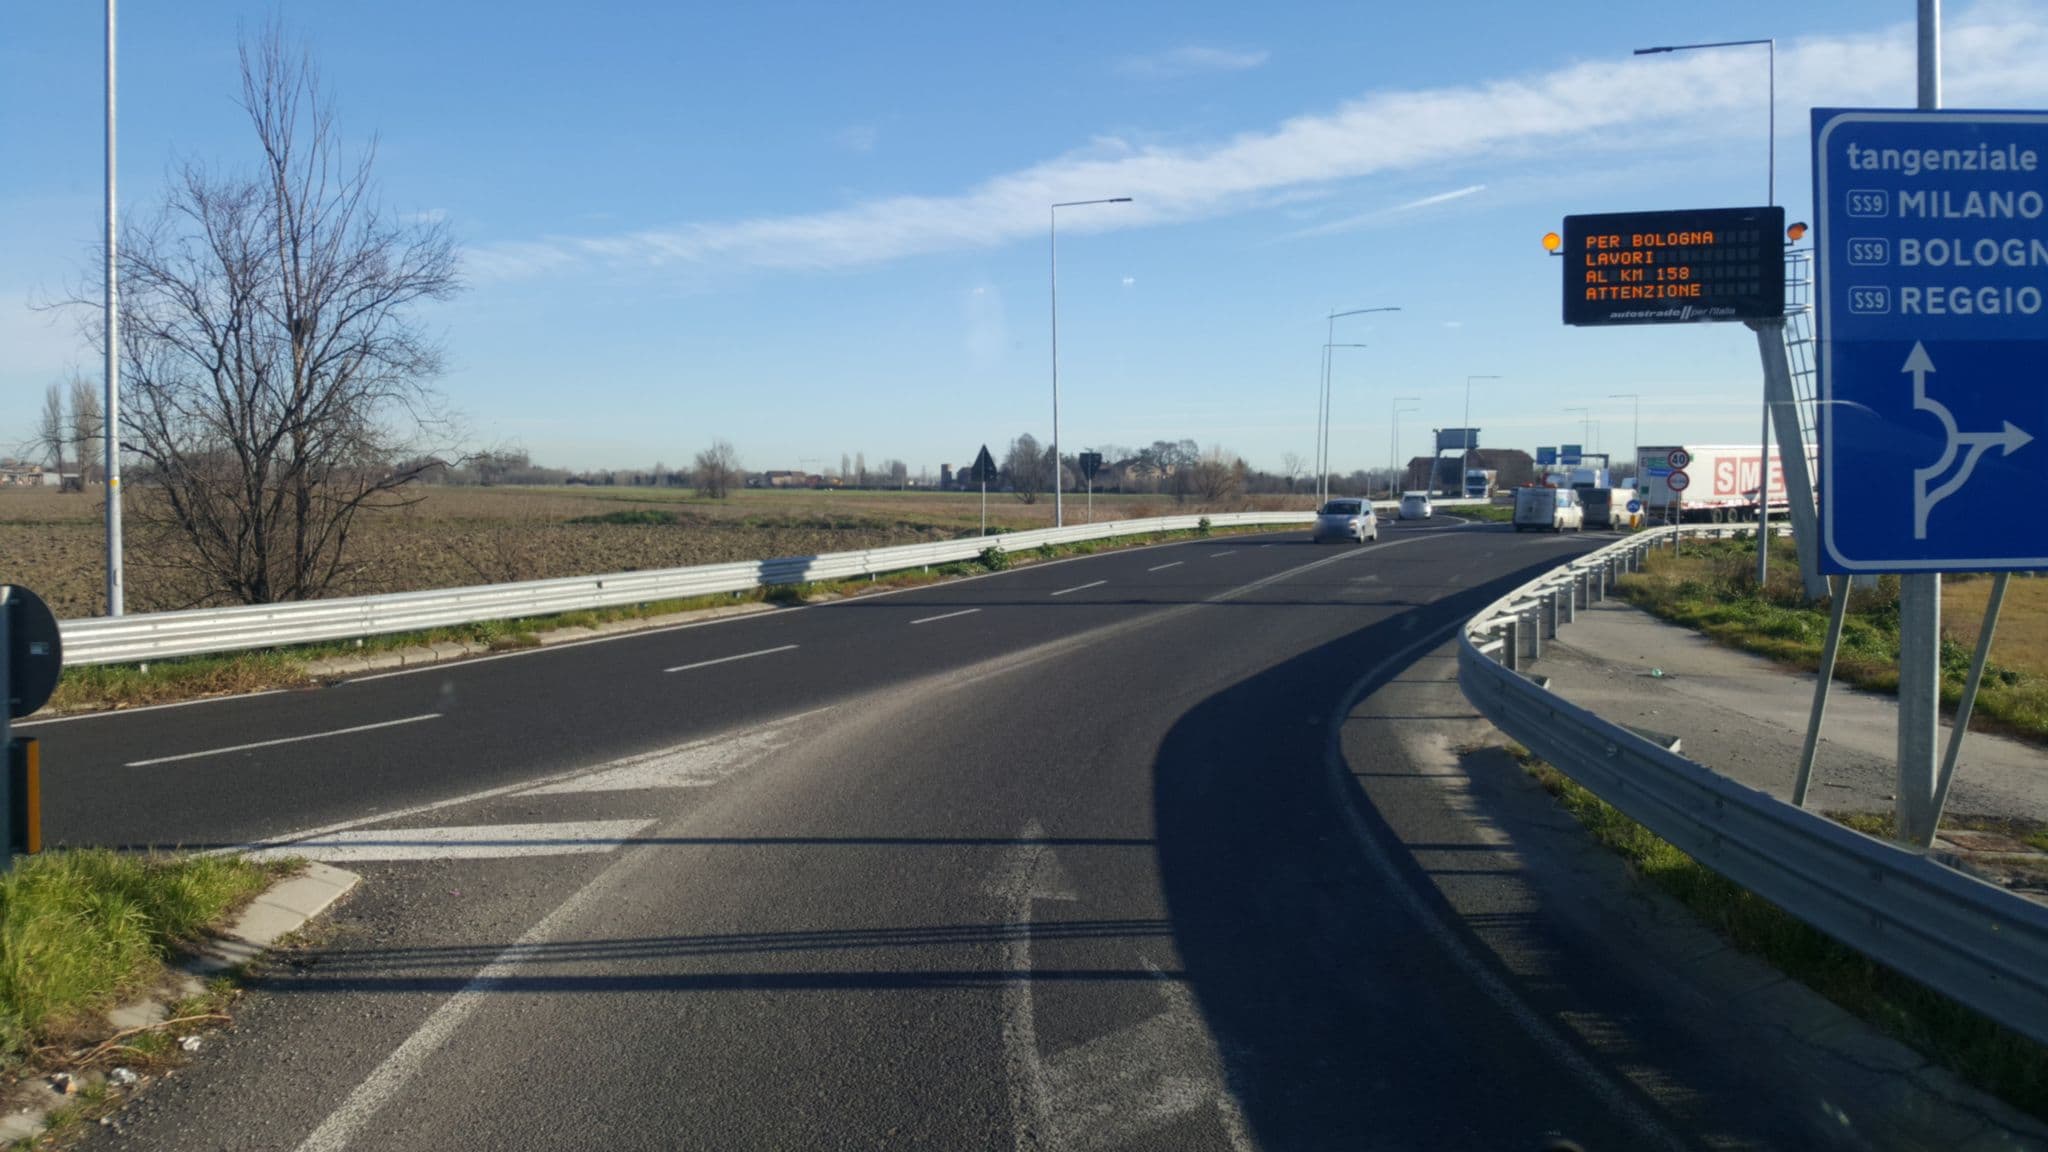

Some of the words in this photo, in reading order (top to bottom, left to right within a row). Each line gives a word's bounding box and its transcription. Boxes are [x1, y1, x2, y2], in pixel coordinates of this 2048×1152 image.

[1847, 142, 2038, 176] tangenziale
[1853, 195, 1882, 212] SS9
[1900, 190, 2044, 219] MILANO
[1586, 235, 1620, 249] PER
[1632, 231, 1713, 247] BOLOGNA
[1586, 251, 1653, 266] LAVORI
[1854, 243, 1884, 260] SS9
[1586, 270, 1608, 283] AL
[1620, 268, 1643, 282] KM
[1657, 266, 1689, 281] 158
[1586, 283, 1702, 300] ATTENZIONE
[1855, 292, 1885, 309] SS9
[1901, 286, 2042, 315] REGGIO
[1672, 454, 1686, 465] 40
